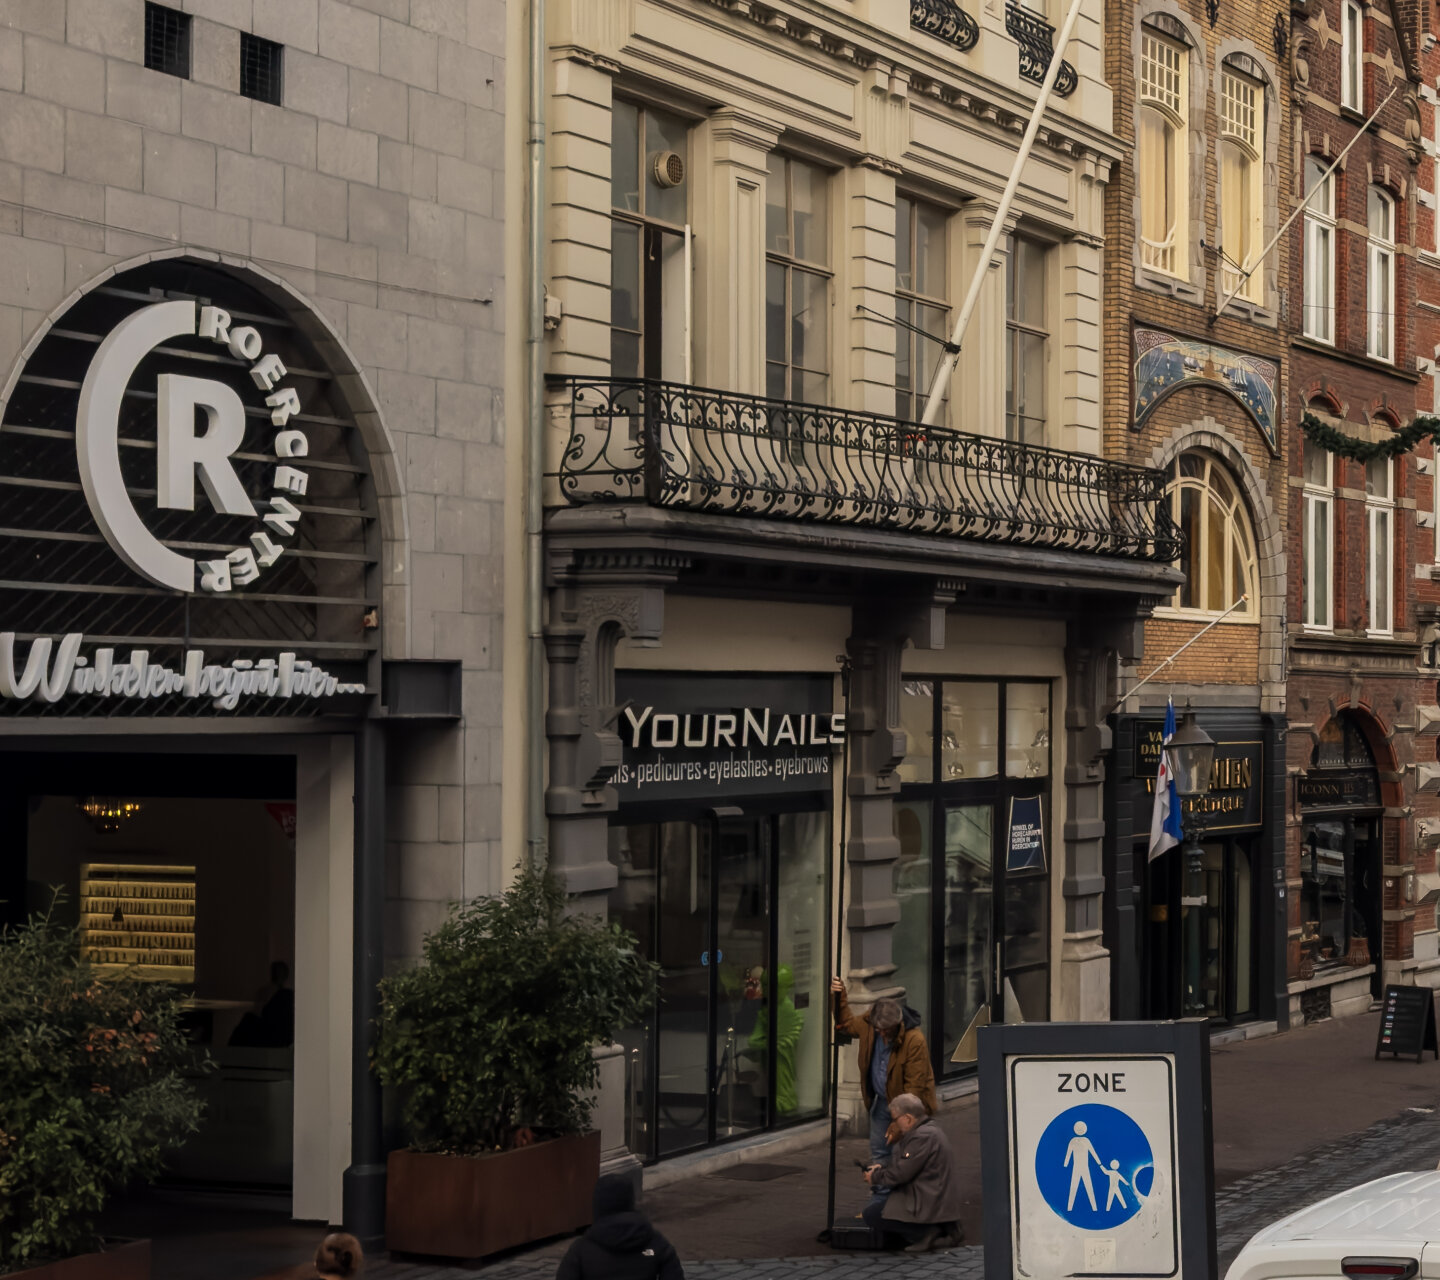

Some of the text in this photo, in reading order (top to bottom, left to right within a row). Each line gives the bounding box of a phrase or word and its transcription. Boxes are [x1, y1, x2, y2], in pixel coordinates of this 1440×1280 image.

[199, 306, 308, 592] ROERCENTER
[0, 632, 183, 703] Winkelen
[183, 650, 279, 710] begint
[637, 753, 701, 788] pedicures
[709, 750, 768, 784] eyelashes
[775, 749, 829, 781] eyebrows
[1058, 1073, 1126, 1092] ZONE
